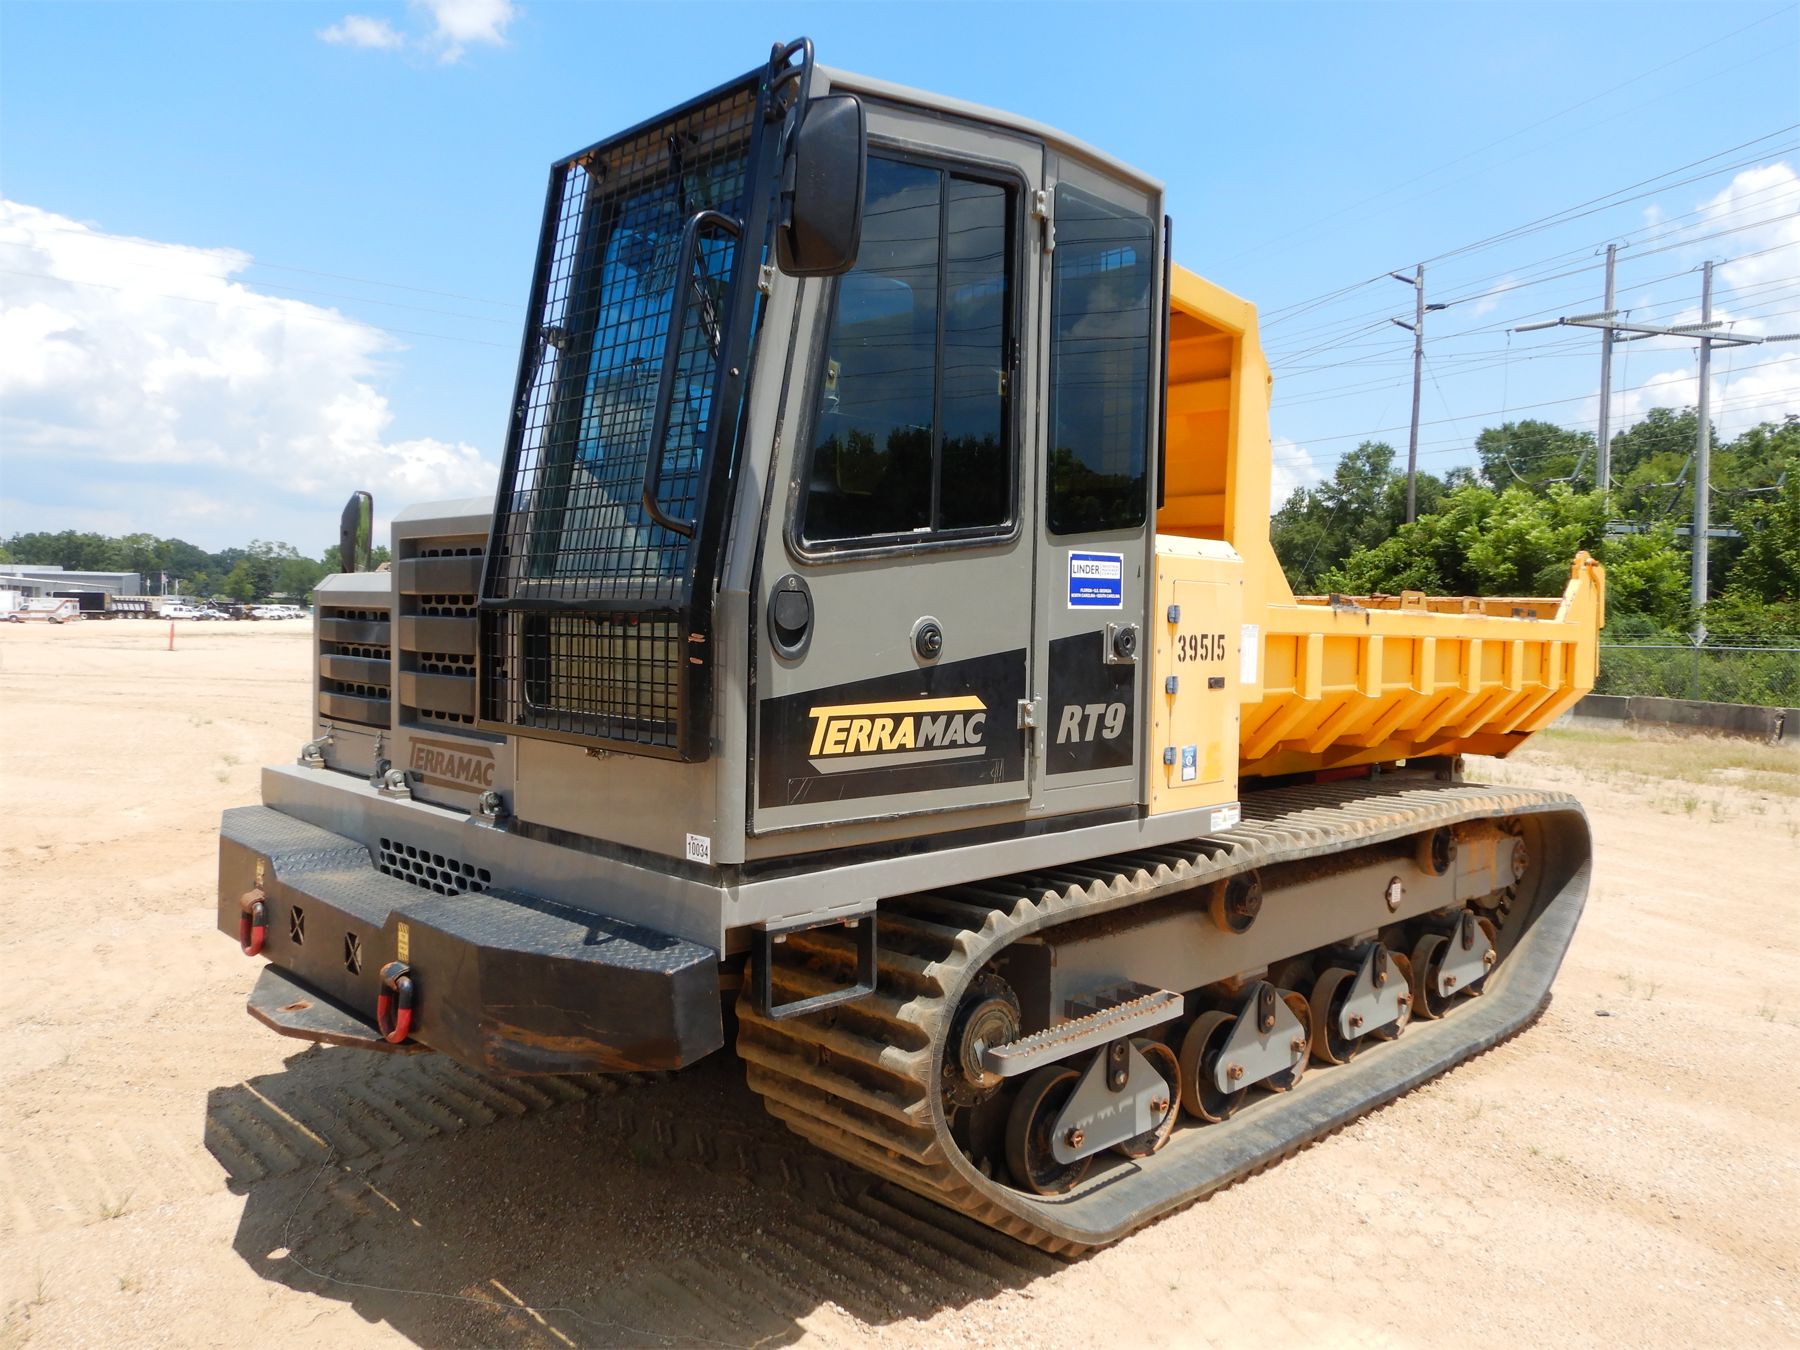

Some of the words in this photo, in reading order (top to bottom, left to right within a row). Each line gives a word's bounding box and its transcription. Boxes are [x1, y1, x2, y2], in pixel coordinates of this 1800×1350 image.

[1072, 563, 1100, 575] LINDER
[1177, 633, 1226, 663] 39515
[808, 695, 988, 756] TERRAMAC
[1056, 702, 1126, 744] RT9
[408, 735, 496, 787] TERRAMAC
[688, 841, 709, 858] 10034
